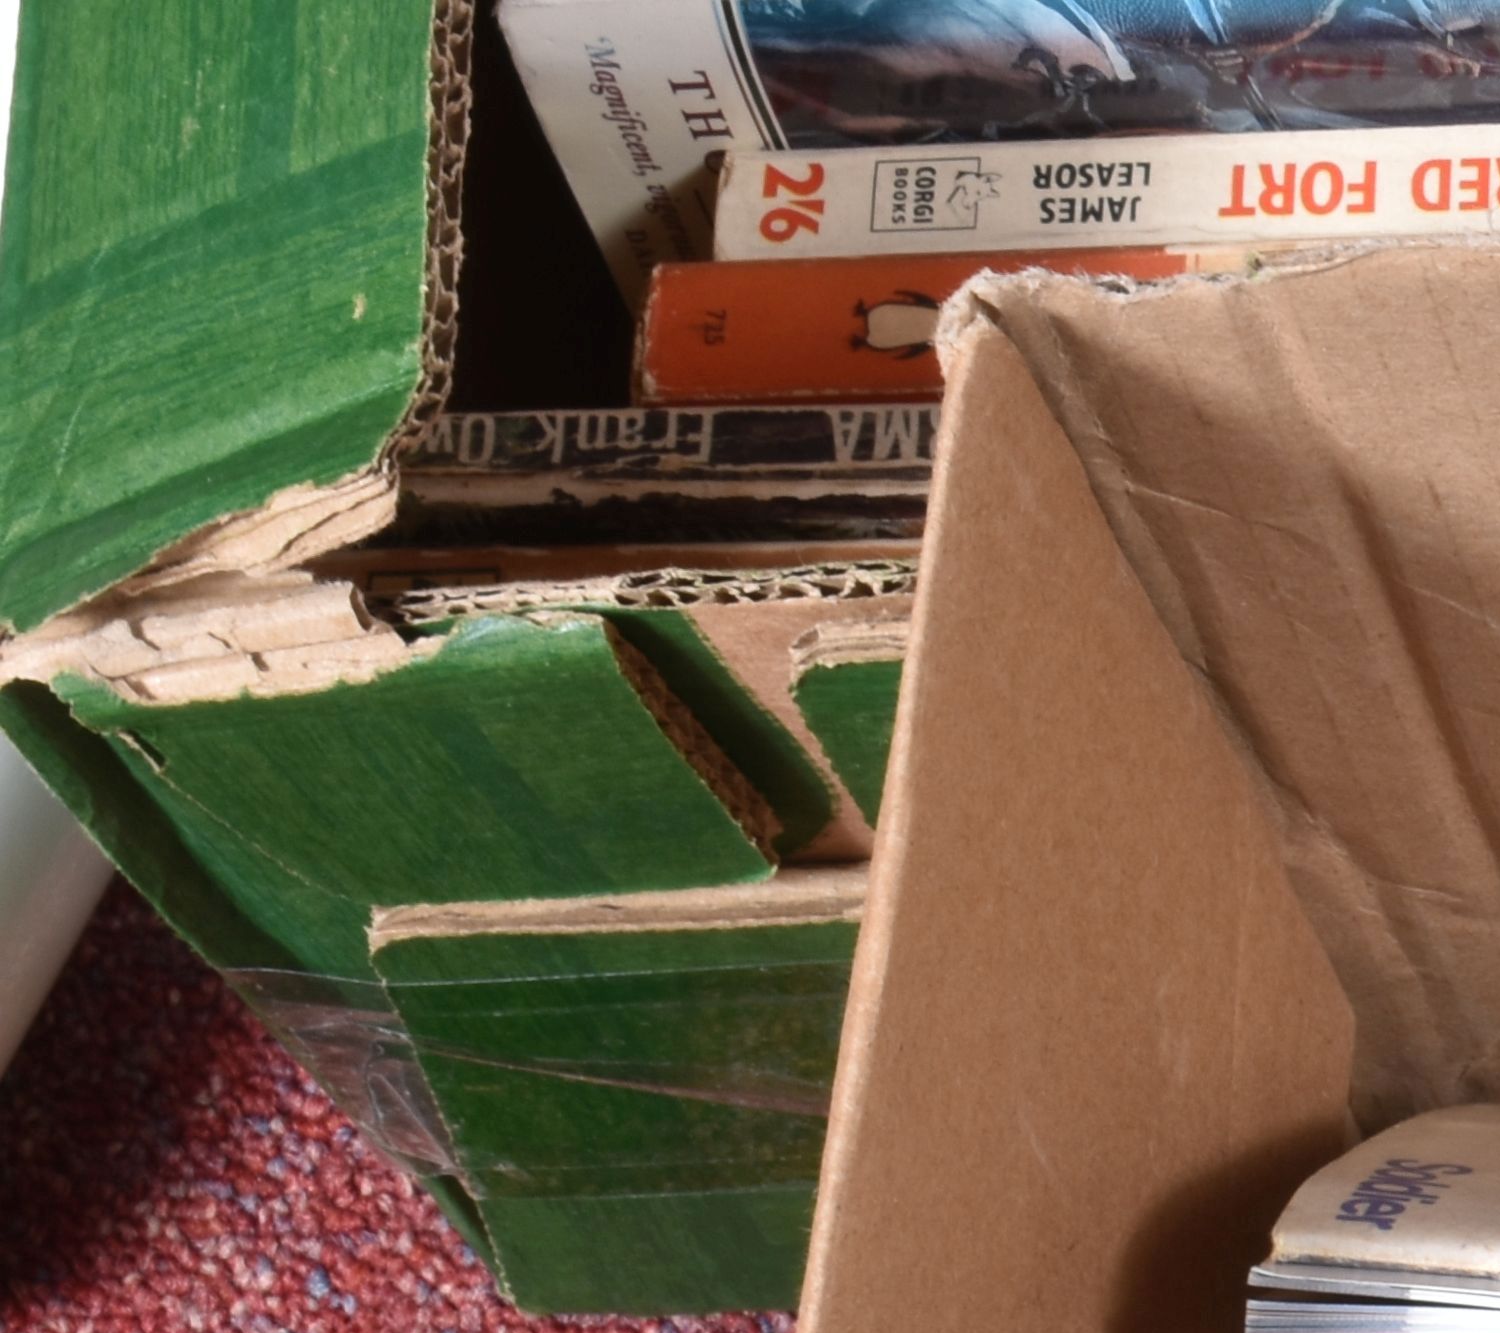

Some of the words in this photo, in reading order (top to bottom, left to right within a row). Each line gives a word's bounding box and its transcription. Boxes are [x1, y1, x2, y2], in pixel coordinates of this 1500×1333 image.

[891, 168, 907, 225] BOOKS
[913, 166, 937, 225] CORGI
[1033, 161, 1151, 191] LEASOR
[1218, 161, 1377, 218] FORT
[1040, 195, 1142, 225] JAMES
[540, 410, 715, 463] Frank
[1334, 1158, 1474, 1232] Soldier
